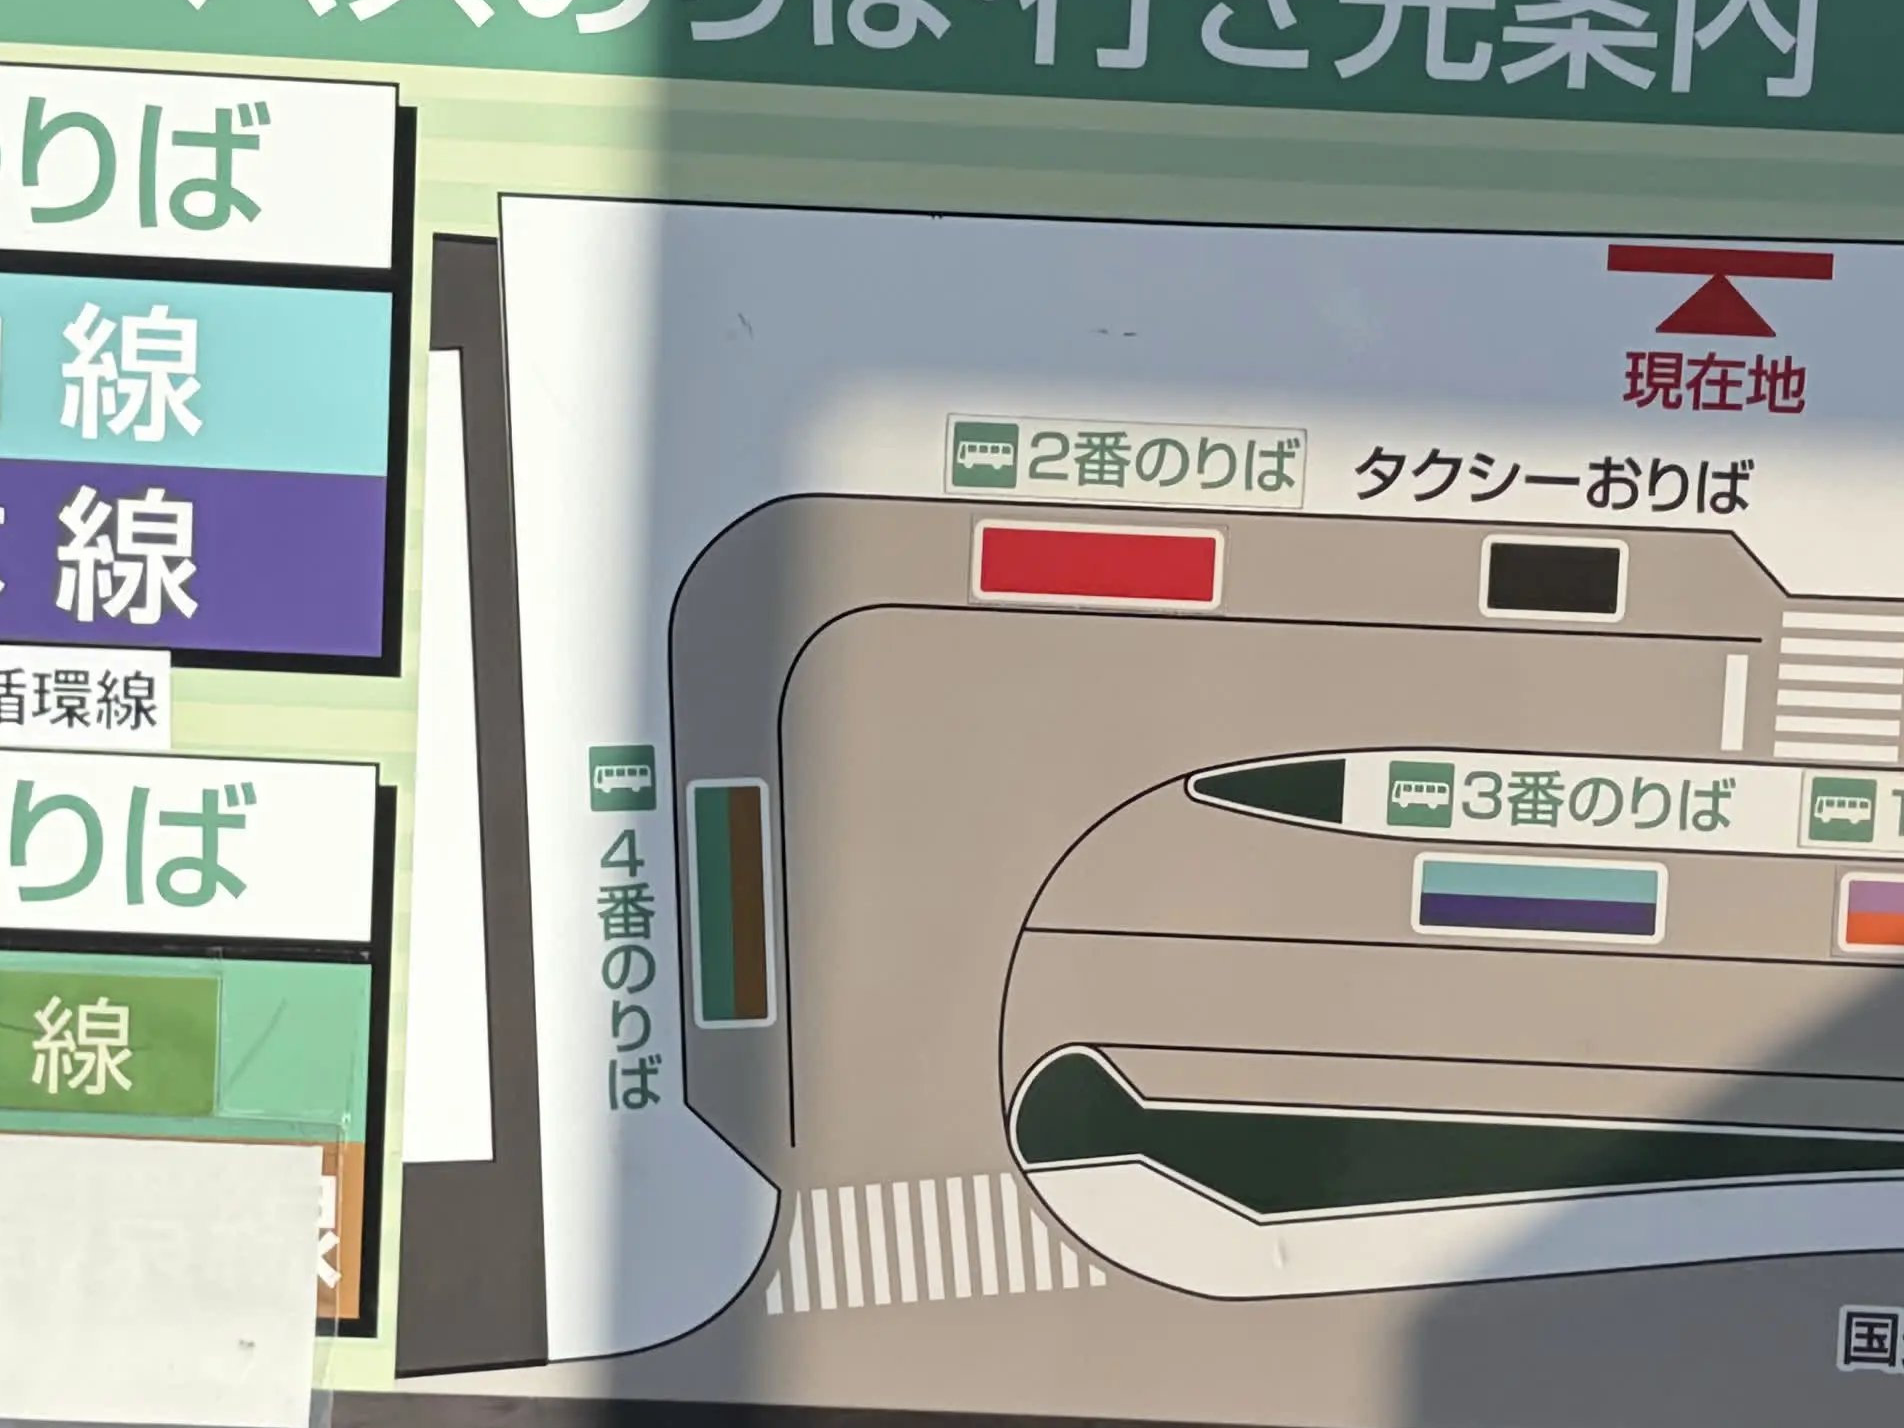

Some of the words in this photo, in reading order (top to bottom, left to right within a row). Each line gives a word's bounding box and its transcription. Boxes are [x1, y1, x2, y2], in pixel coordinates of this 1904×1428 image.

[1619, 348, 1810, 417] 現在地
[1026, 428, 1303, 497] 2番のりば
[1352, 442, 1759, 519] タクシーおりば
[1460, 768, 1738, 837] 3番のりば
[596, 825, 662, 1113] 4番のりば
